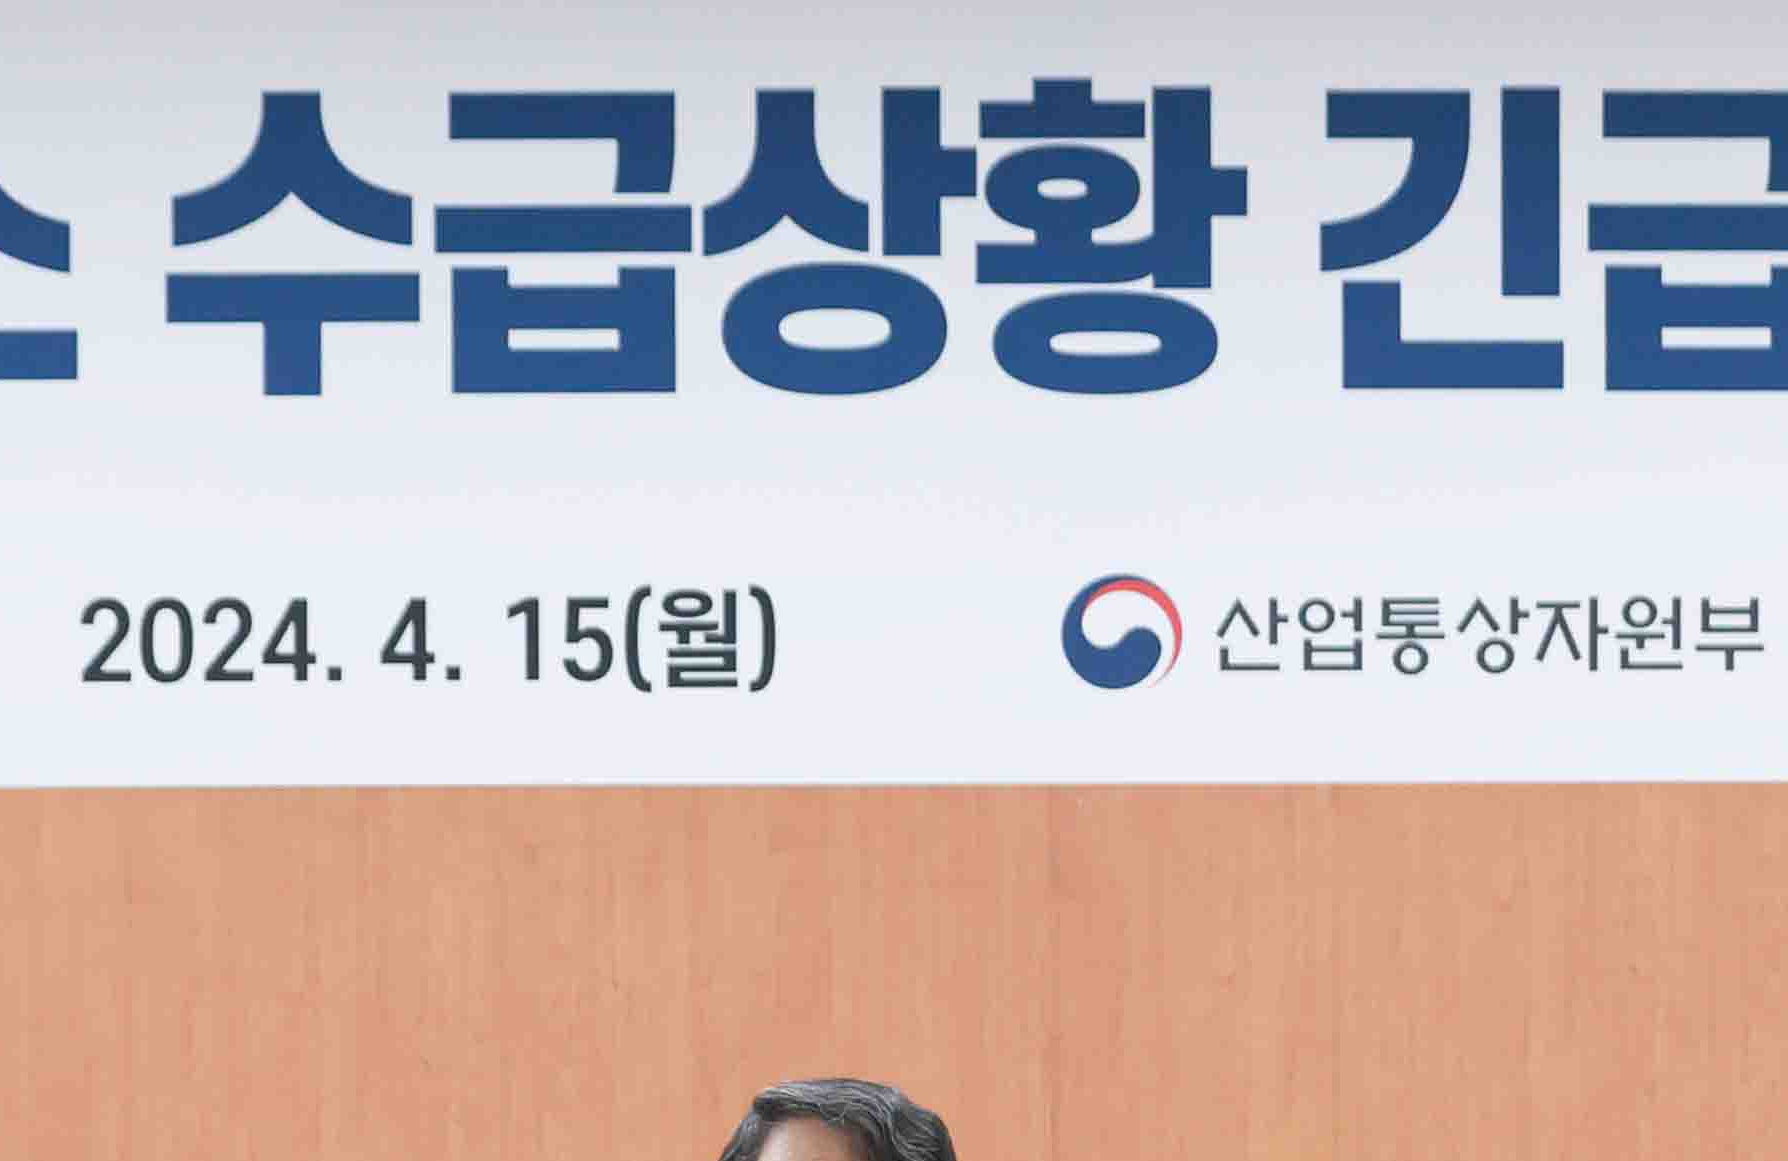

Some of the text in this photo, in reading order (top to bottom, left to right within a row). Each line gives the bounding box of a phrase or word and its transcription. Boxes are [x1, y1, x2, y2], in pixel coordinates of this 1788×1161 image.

[165, 78, 1249, 397] 수급상황
[80, 584, 777, 694] 2024. 4. 15(월)
[1215, 595, 1766, 676] 산업통상자원부
